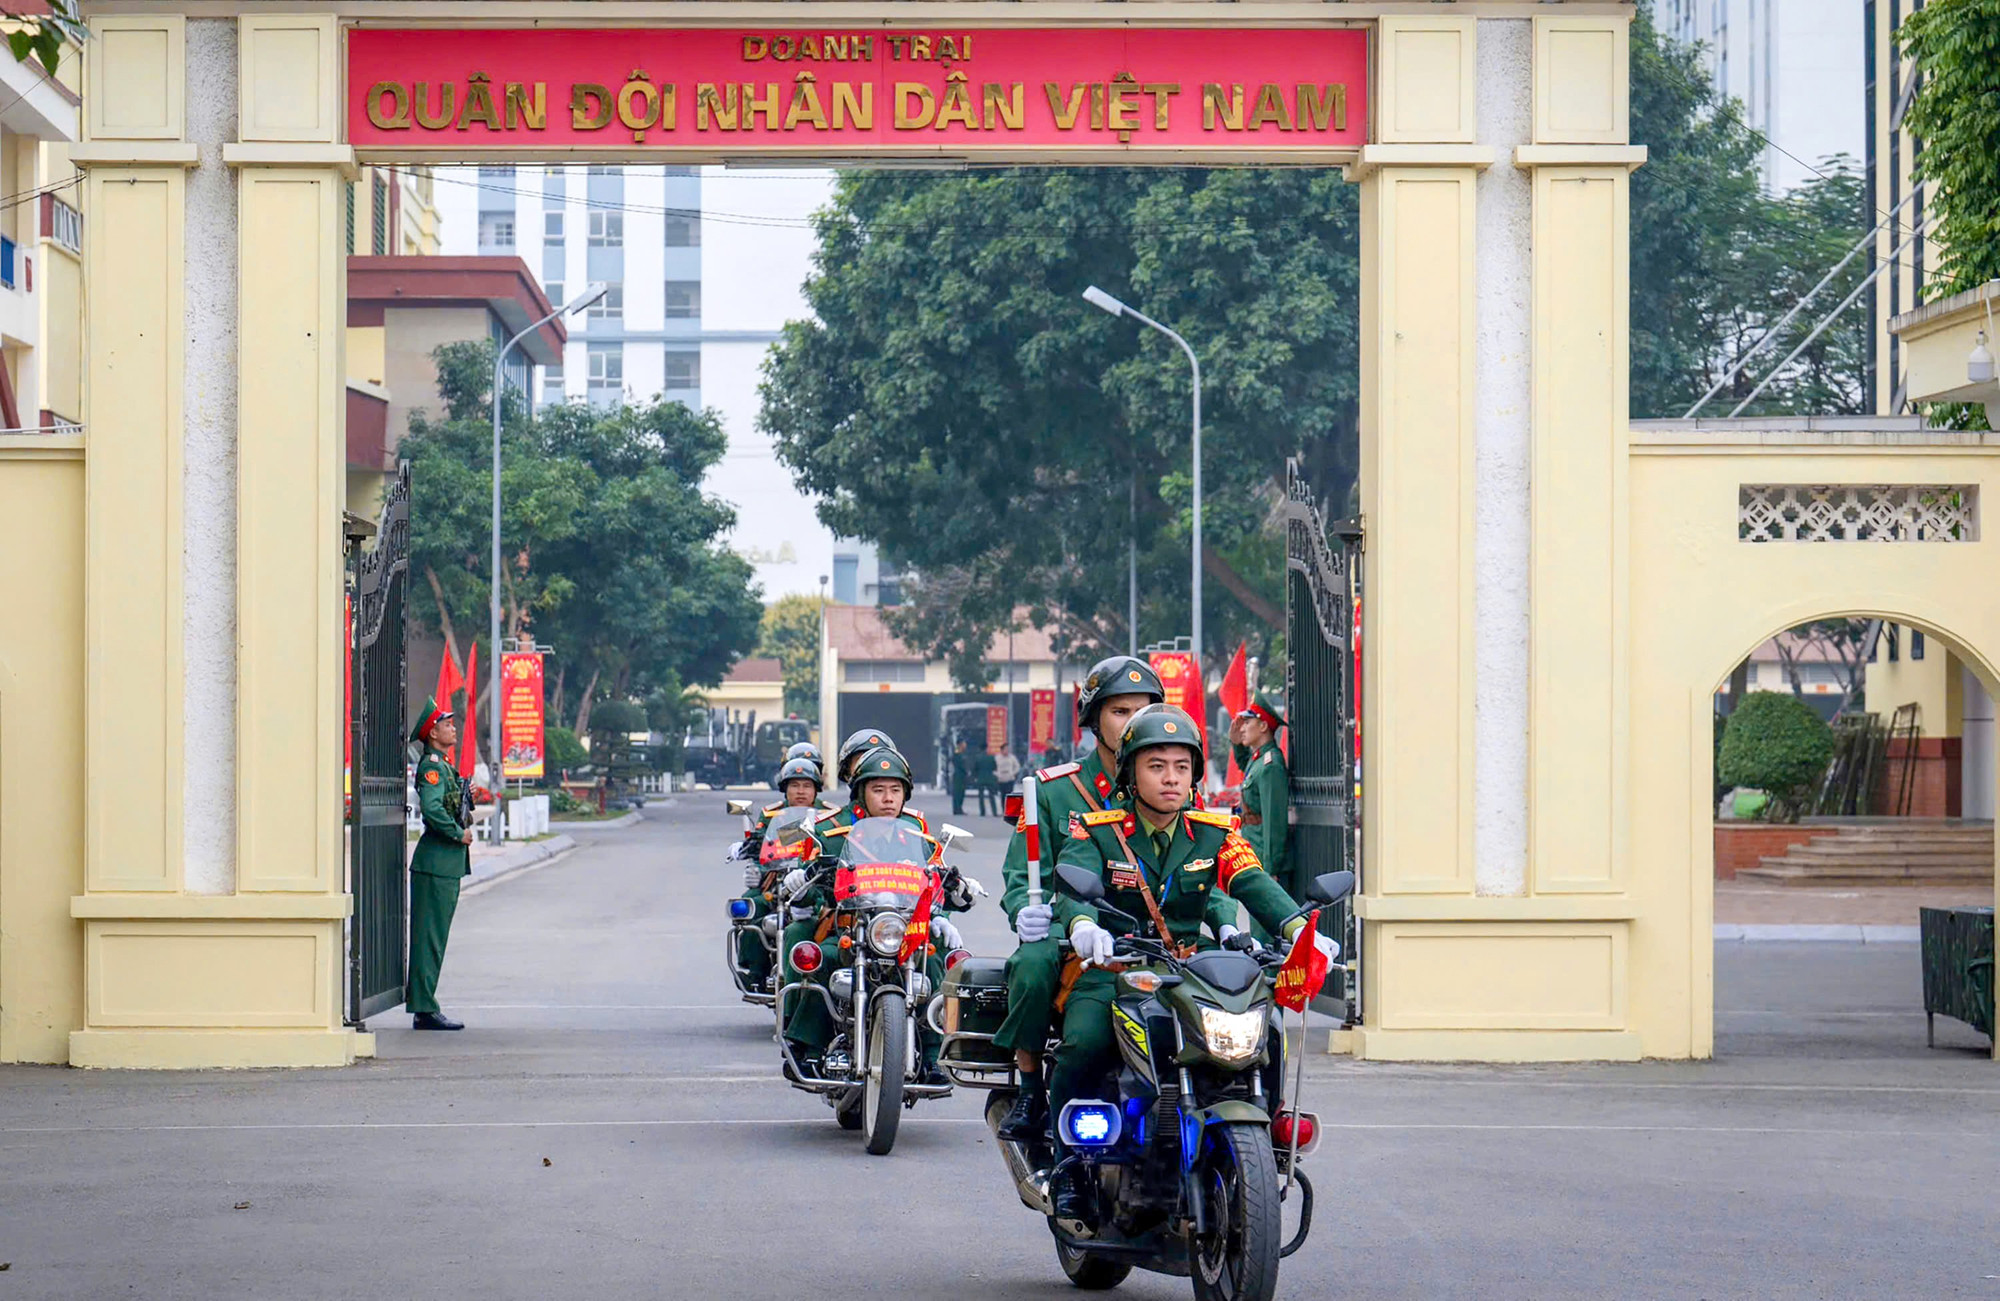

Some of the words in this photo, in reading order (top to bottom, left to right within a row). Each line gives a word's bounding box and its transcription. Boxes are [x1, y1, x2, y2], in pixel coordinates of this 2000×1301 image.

[742, 35, 873, 61] DOANH
[887, 35, 972, 68] TRẠI
[366, 71, 546, 131] QUÂN
[569, 69, 677, 142] ĐỘI
[696, 71, 873, 131] NHÂN
[894, 71, 1025, 131] DÂN
[1044, 71, 1181, 142] VIỆT
[1203, 82, 1347, 131] NAM
